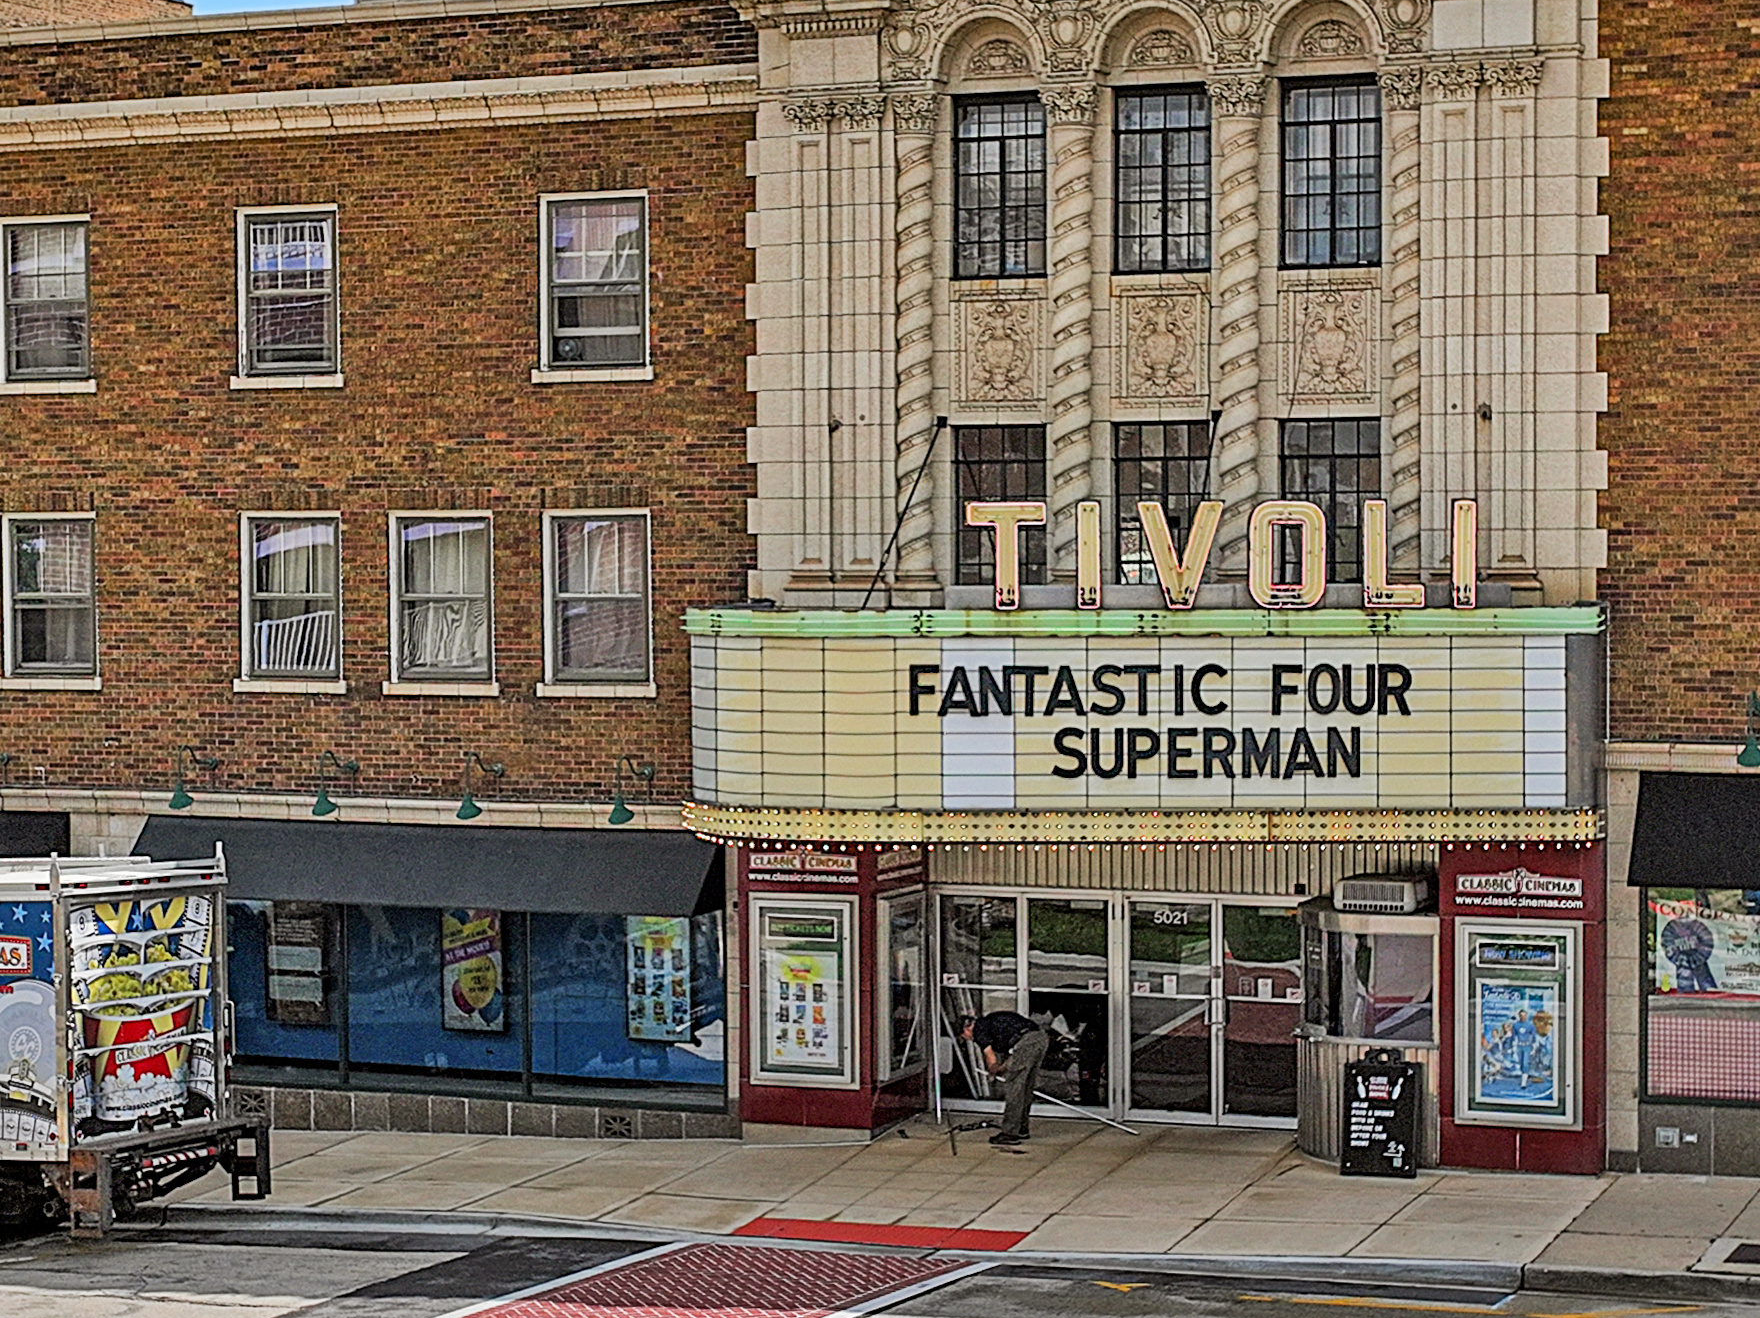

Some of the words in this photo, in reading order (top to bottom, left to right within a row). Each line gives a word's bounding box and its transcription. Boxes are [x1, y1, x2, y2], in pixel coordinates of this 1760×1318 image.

[965, 499, 1477, 610] TIVOLI
[908, 663, 1229, 717] FANTASTIC
[1271, 663, 1413, 717] FOUR
[1051, 726, 1362, 780] SUPERMAN
[753, 855, 797, 868] CLASSIC
[808, 857, 852, 868] CINEMAS
[748, 872, 858, 883] www.classiccinemas.com
[1461, 878, 1512, 891] CLASSIC
[1525, 880, 1576, 893] CINEMAS
[1455, 895, 1584, 909] www.classiccinemas.com
[1153, 910, 1188, 925] 5021
